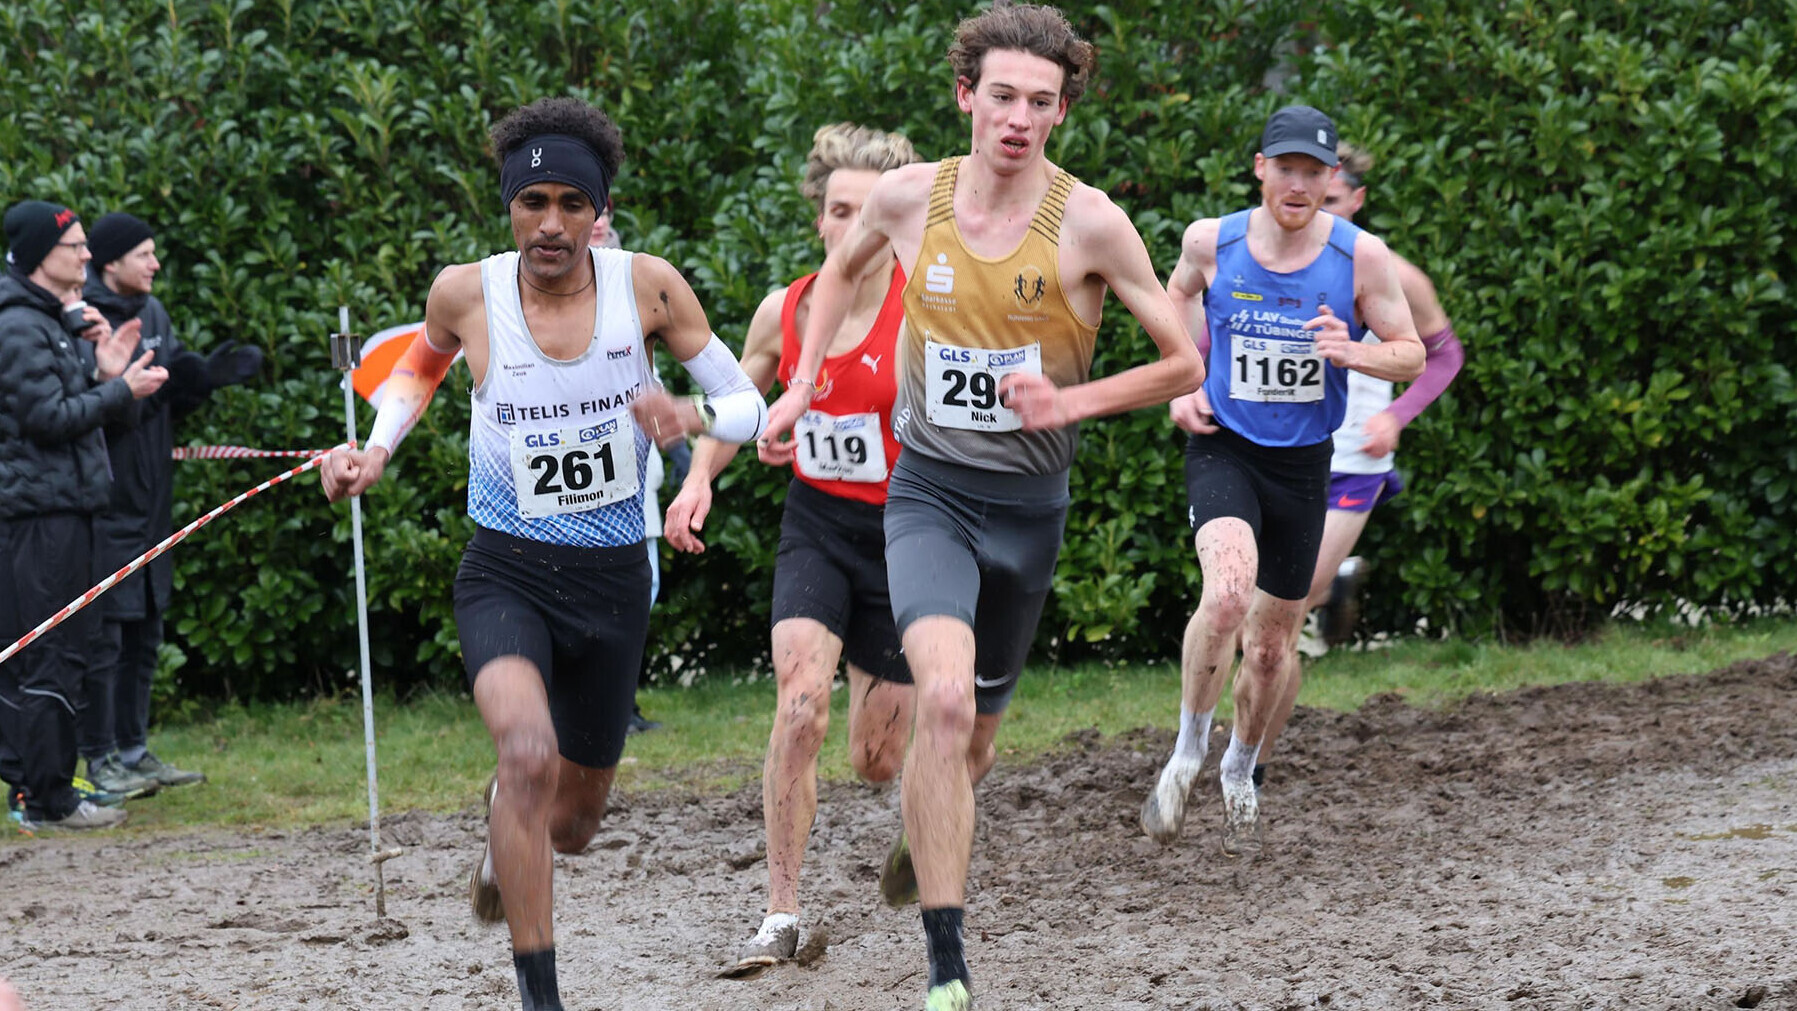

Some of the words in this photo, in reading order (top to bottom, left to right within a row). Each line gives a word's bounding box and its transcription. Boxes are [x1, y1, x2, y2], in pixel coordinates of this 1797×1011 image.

[1253, 310, 1280, 323] LAV
[1253, 322, 1316, 340] TÜBINGE
[1243, 340, 1267, 351] GLS
[939, 348, 971, 363] GLS
[503, 362, 535, 371] Maximilian
[1236, 354, 1320, 387] 1162
[517, 404, 570, 421] TELIS
[580, 382, 641, 416] FINANZ
[971, 411, 998, 424] Nick
[524, 432, 560, 448] GLS
[804, 429, 868, 465] 119
[529, 441, 616, 496] 261
[557, 490, 604, 507] Filimon
